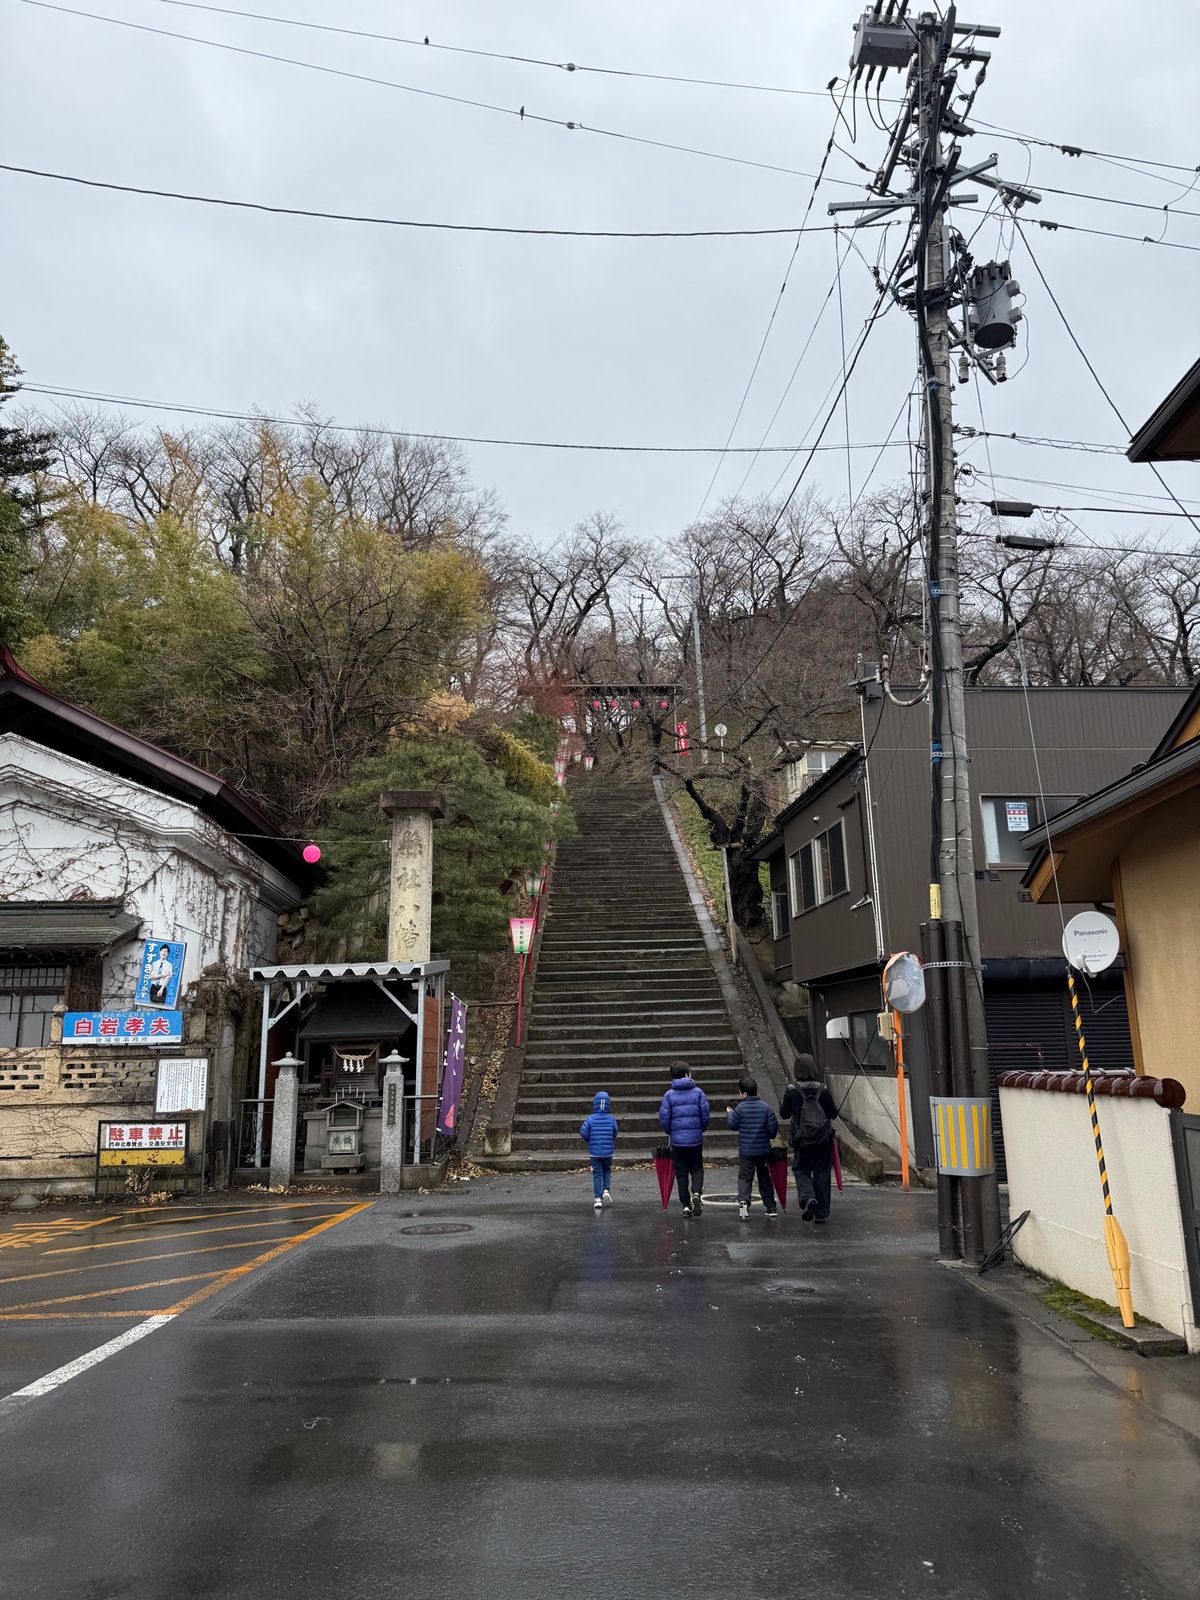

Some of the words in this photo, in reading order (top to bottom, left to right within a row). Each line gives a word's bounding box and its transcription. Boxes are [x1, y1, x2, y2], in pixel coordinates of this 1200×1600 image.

[394, 828, 424, 962] 縣社八幡
[75, 1017, 170, 1036] 白岩孝夫
[109, 1126, 183, 1141] 駐車禁止
